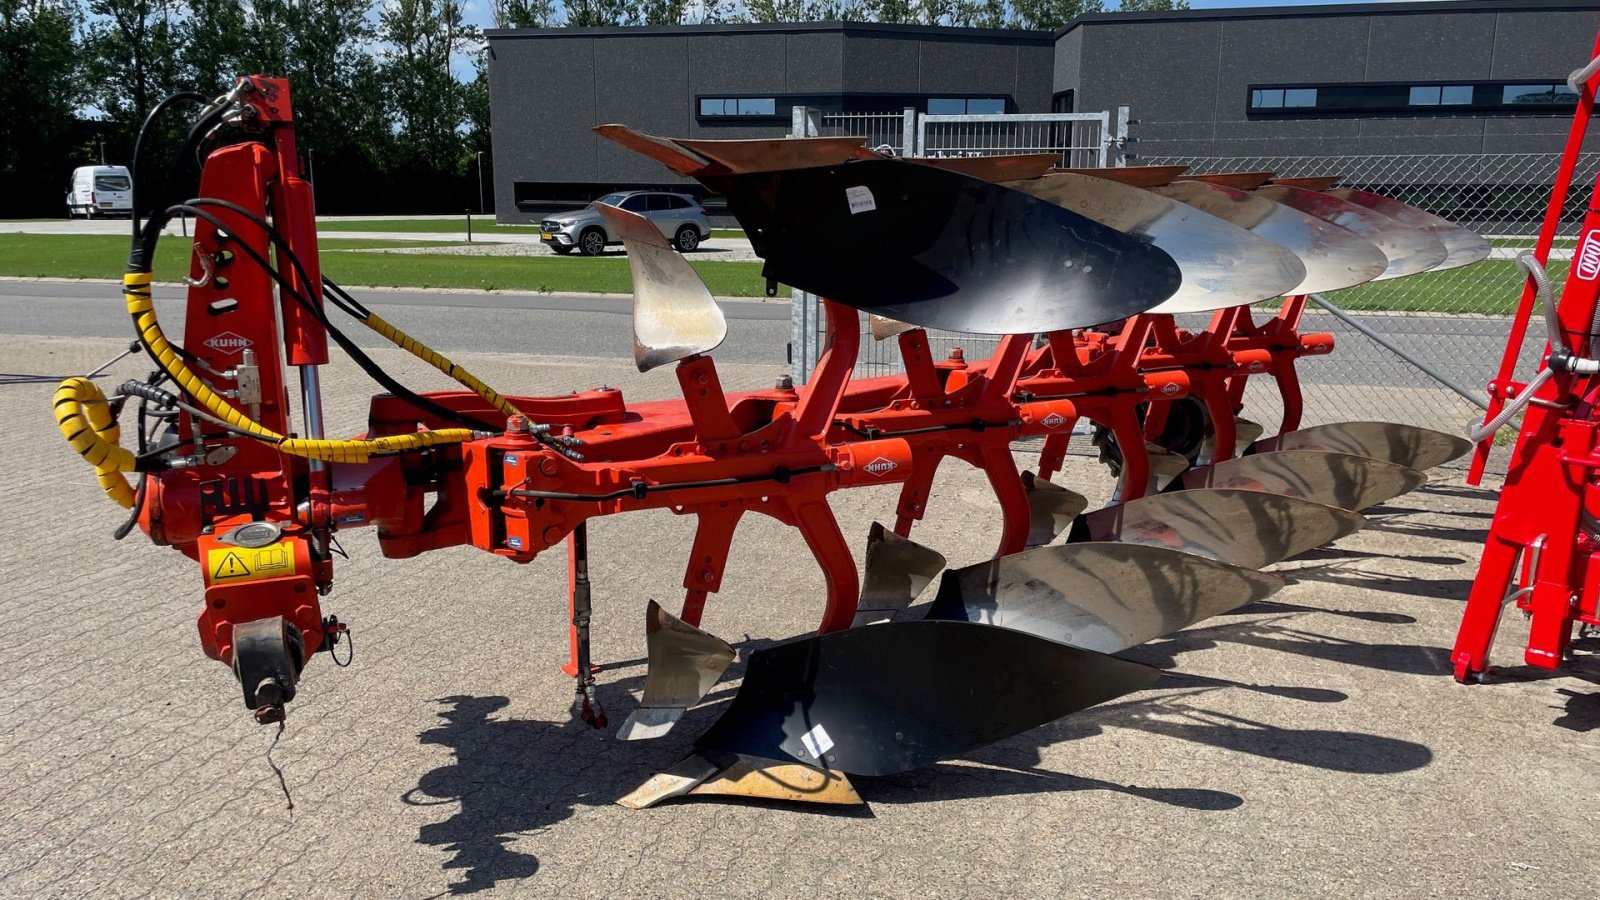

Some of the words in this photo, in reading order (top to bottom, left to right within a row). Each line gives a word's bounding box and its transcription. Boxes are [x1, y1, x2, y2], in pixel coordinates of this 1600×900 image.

[210, 338, 247, 347] KUHN
[1044, 417, 1063, 425] KUHN
[867, 462, 893, 471] KUHN
